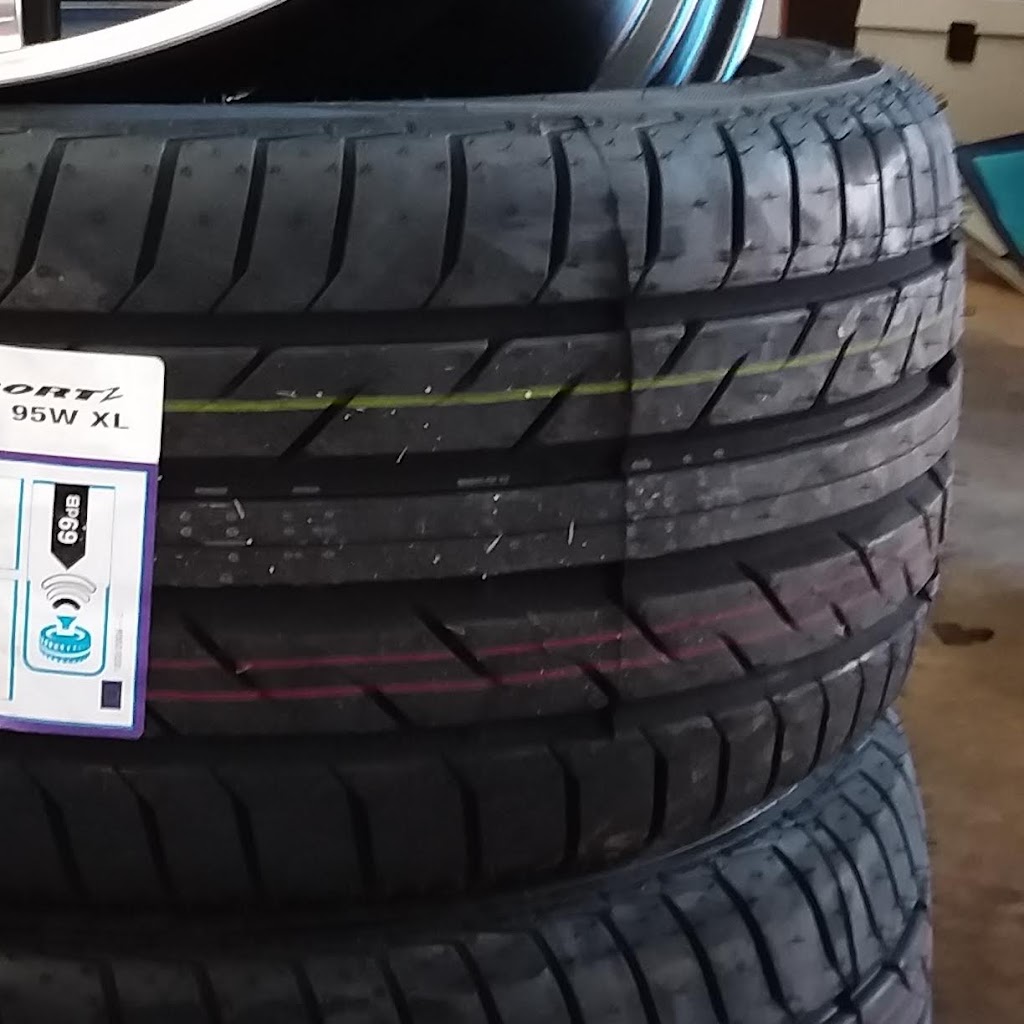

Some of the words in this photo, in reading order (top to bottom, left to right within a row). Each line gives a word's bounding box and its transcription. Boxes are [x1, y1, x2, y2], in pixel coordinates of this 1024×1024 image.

[12, 404, 78, 425] 95W
[91, 411, 129, 429] XL
[57, 494, 81, 545] 69dB
